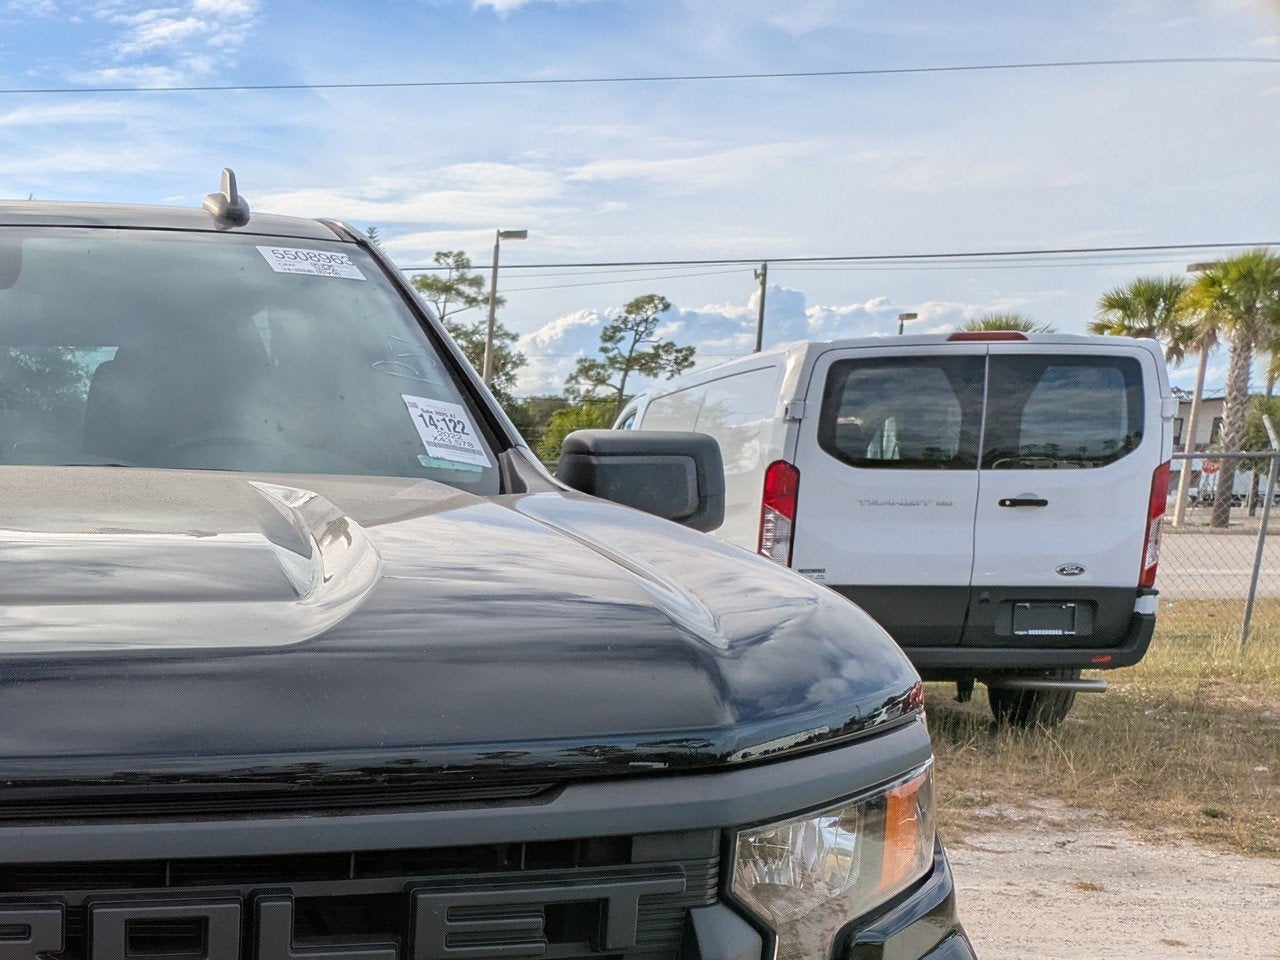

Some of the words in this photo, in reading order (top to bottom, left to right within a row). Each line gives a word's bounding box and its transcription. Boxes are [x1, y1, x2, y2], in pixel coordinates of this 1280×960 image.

[270, 249, 355, 266] 5508963
[418, 413, 470, 436] 14:122
[437, 430, 462, 439] 2022
